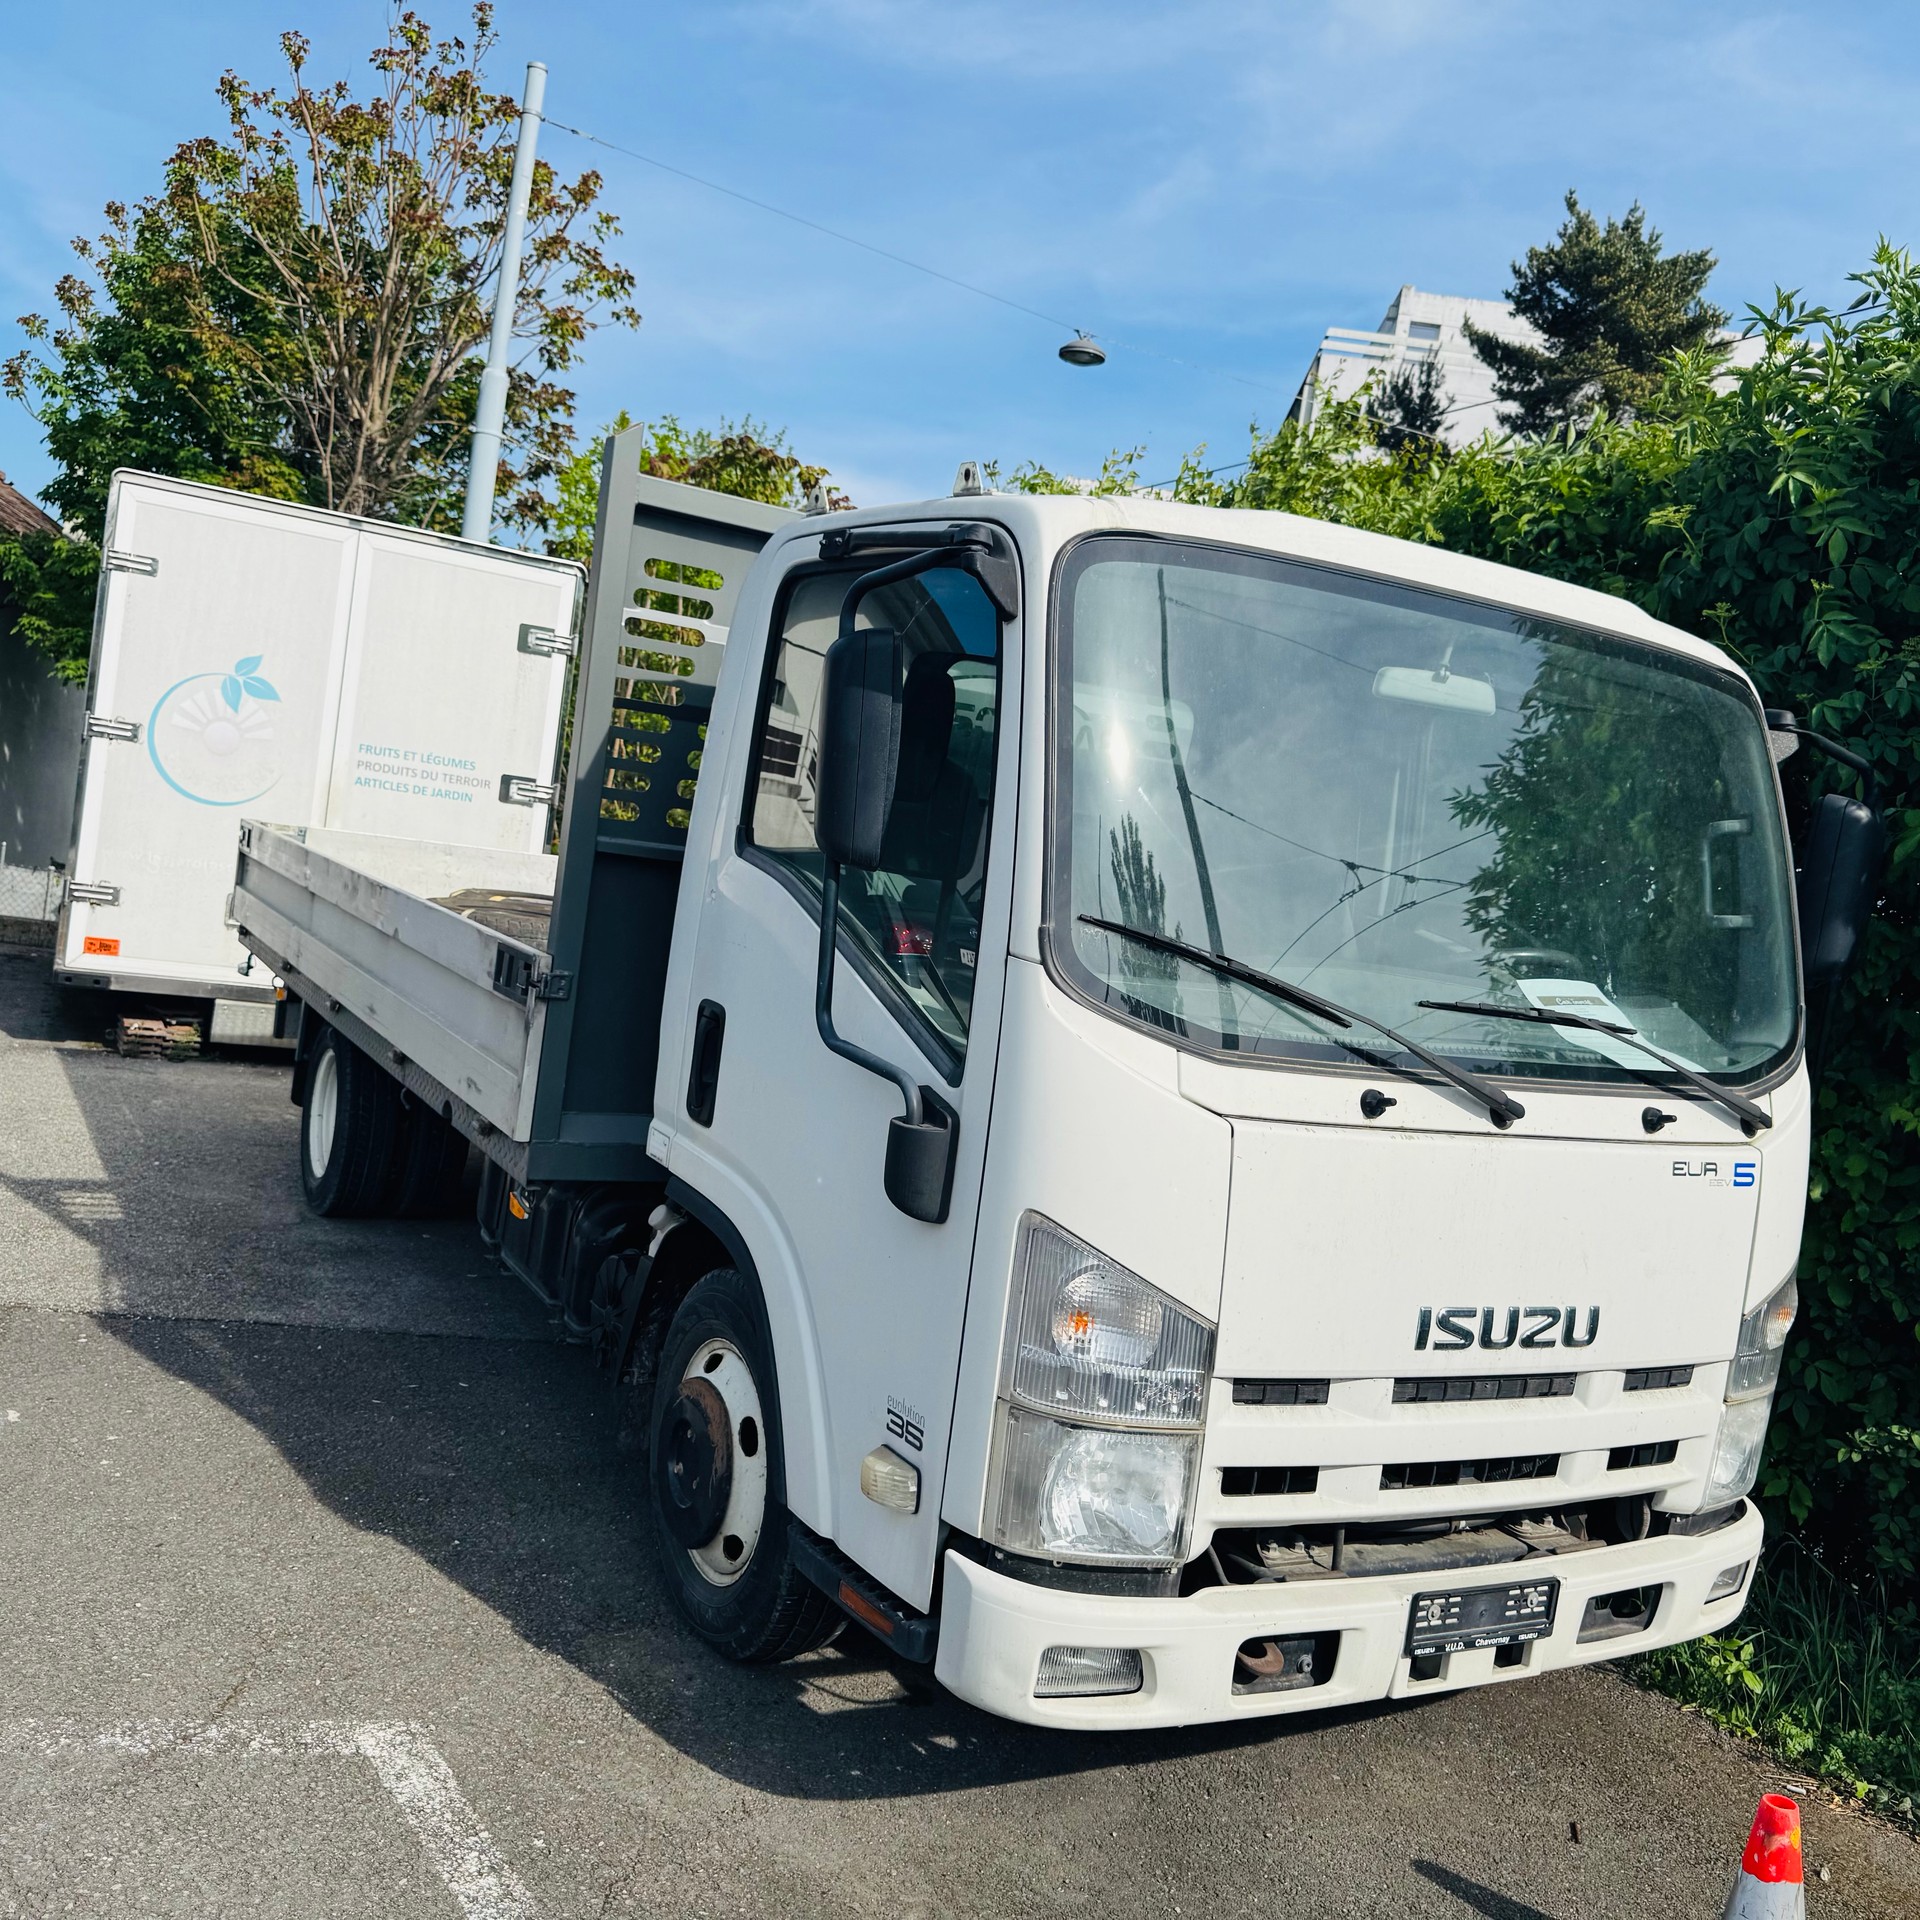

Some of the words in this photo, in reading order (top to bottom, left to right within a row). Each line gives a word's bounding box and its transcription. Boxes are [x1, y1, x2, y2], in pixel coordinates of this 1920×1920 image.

[358, 743, 400, 759] FRUITS
[403, 751, 417, 762] ET
[421, 752, 476, 771] LÉGUMES
[354, 776, 409, 793] ARTICLES
[413, 785, 428, 796] DE
[431, 788, 473, 803] JARDIN
[357, 760, 418, 778] PRODUITS
[421, 769, 438, 782] DU
[443, 773, 491, 790] TERROIR
[1733, 1163, 1756, 1187] 5
[1414, 1305, 1600, 1351] ISUZU
[887, 1394, 926, 1428] evolution
[886, 1407, 924, 1452] 35
[1414, 1646, 1436, 1655] ISUZU
[1475, 1636, 1511, 1647] Chavornay
[1518, 1632, 1538, 1641] ISUZU
